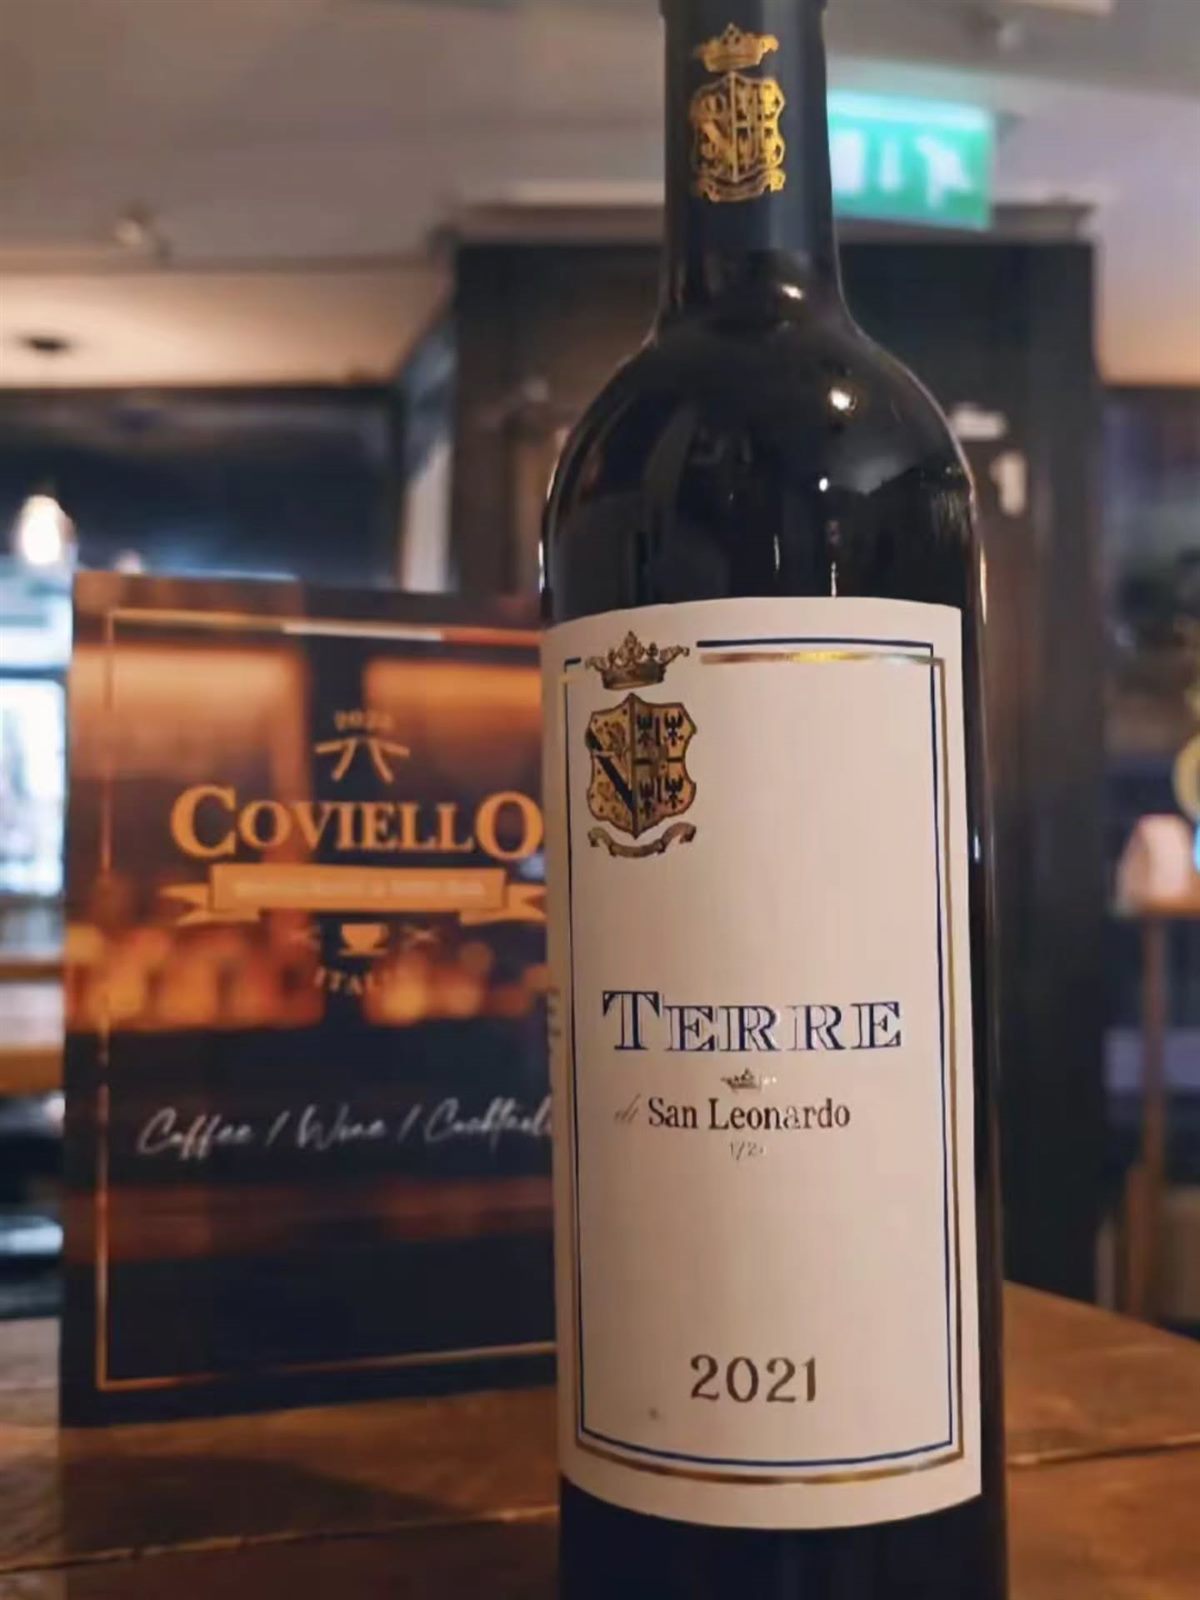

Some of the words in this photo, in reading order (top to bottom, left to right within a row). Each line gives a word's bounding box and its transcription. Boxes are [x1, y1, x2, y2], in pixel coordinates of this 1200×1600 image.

[170, 785, 544, 861] COVIELLO
[602, 990, 902, 1052] TERRE
[137, 1106, 252, 1160] Coffee
[298, 1103, 385, 1151] Wine
[648, 1097, 698, 1129] San
[708, 1097, 850, 1131] Leonardo
[690, 1354, 817, 1403] 2021
